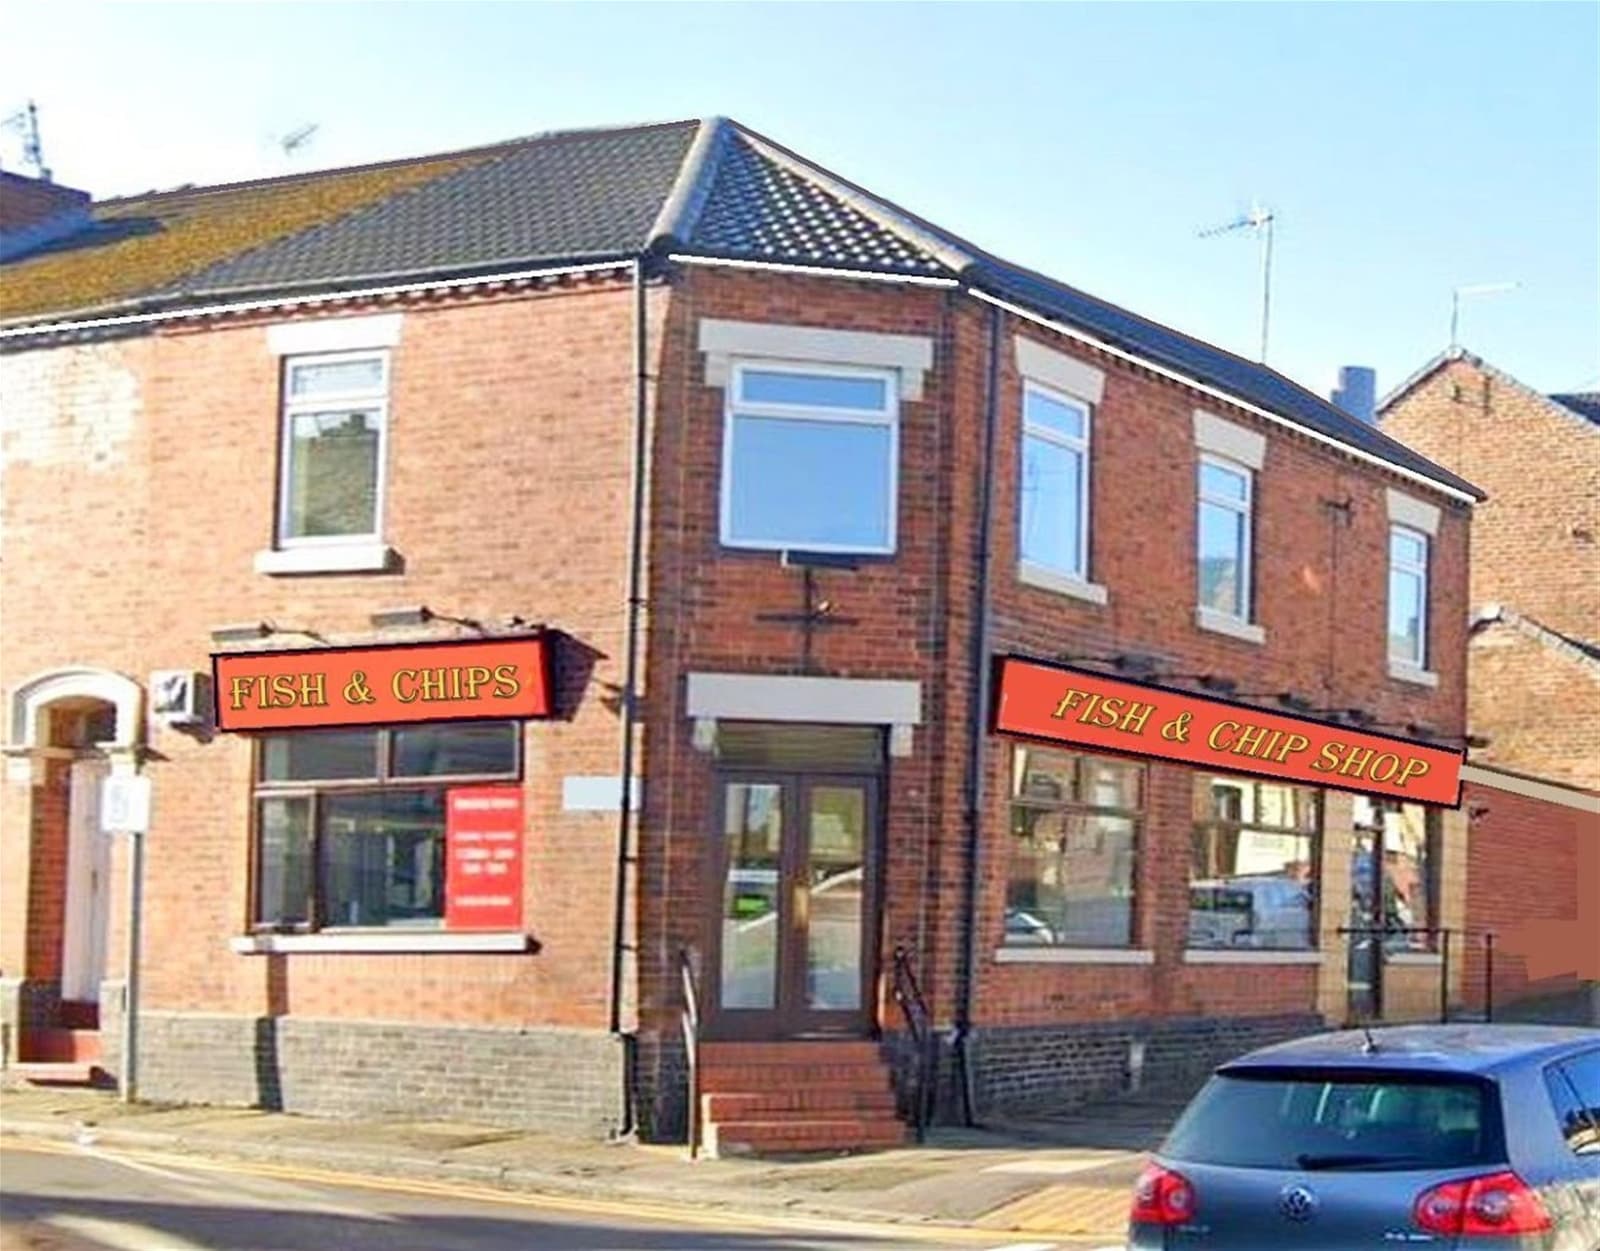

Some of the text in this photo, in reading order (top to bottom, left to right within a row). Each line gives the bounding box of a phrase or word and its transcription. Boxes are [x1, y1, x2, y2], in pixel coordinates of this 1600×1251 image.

[231, 664, 520, 710] FISH & CHIPS
[1052, 688, 1431, 787] FISH & CHIP SHOP
